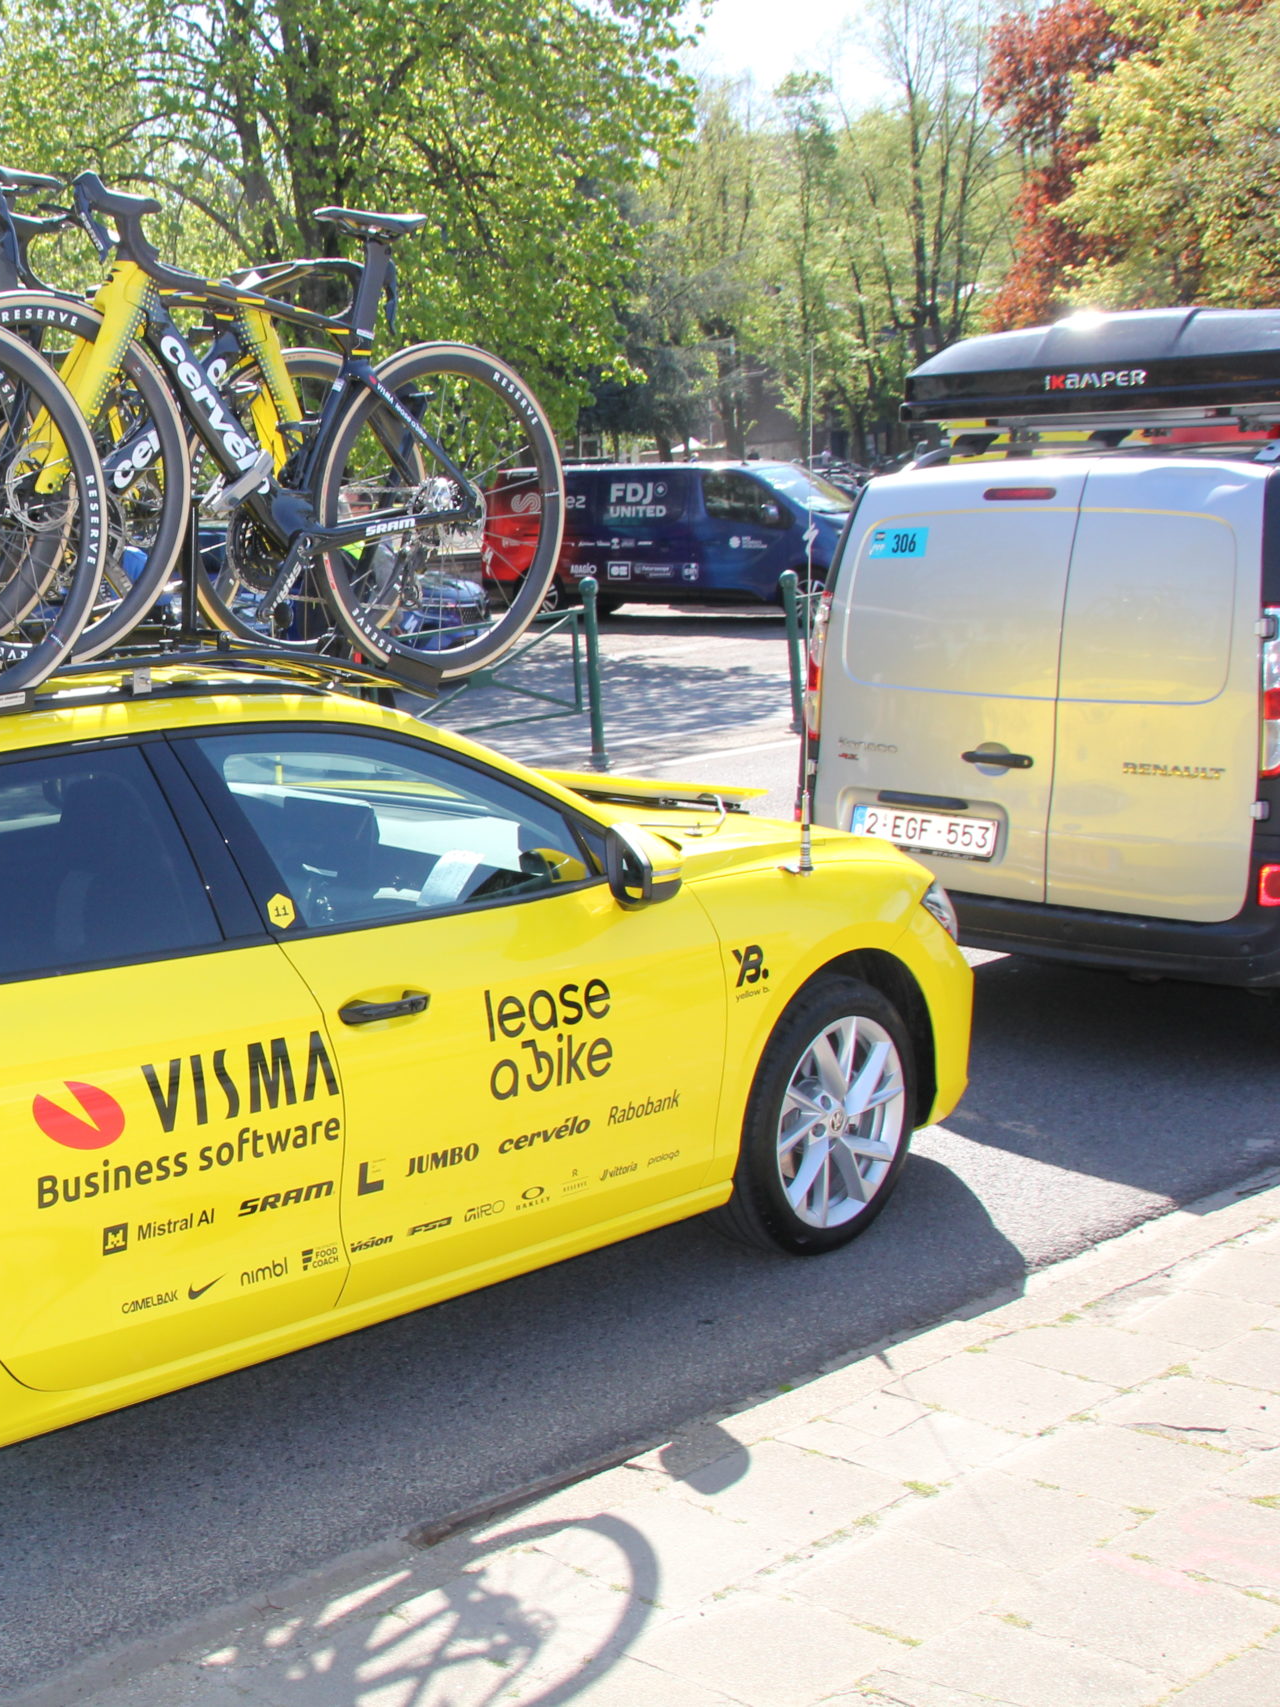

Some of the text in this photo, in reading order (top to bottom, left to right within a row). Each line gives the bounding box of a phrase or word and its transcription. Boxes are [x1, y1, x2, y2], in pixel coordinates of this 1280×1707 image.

[1, 310, 78, 328] RESERVE
[493, 371, 539, 427] RESERVE
[610, 482, 653, 503] FDJ
[85, 474, 100, 566] RESERVE
[609, 506, 666, 518] UNITED
[365, 518, 415, 537] SRAM
[892, 533, 917, 553] 306
[1122, 762, 1226, 780] RENAULT
[736, 990, 761, 1003] yellow
[484, 978, 611, 1042] lease
[140, 1030, 340, 1133] VISMA
[37, 1117, 341, 1209] Business software
[137, 1213, 194, 1241] Mistral
[197, 1208, 216, 1227] AI
[237, 1180, 335, 1217] SRAM
[405, 1142, 480, 1177] JUMBO
[498, 1115, 591, 1155] cervélo
[607, 1089, 681, 1126] Rabobank
[121, 1290, 178, 1314] CAMELBAK
[240, 1257, 288, 1286] nimbl
[315, 1247, 338, 1259] FOOD
[464, 1200, 505, 1223] GIRO
[515, 1196, 551, 1212] OAKLEY
[647, 1149, 681, 1168] prologo
[312, 1255, 339, 1269] COACH
